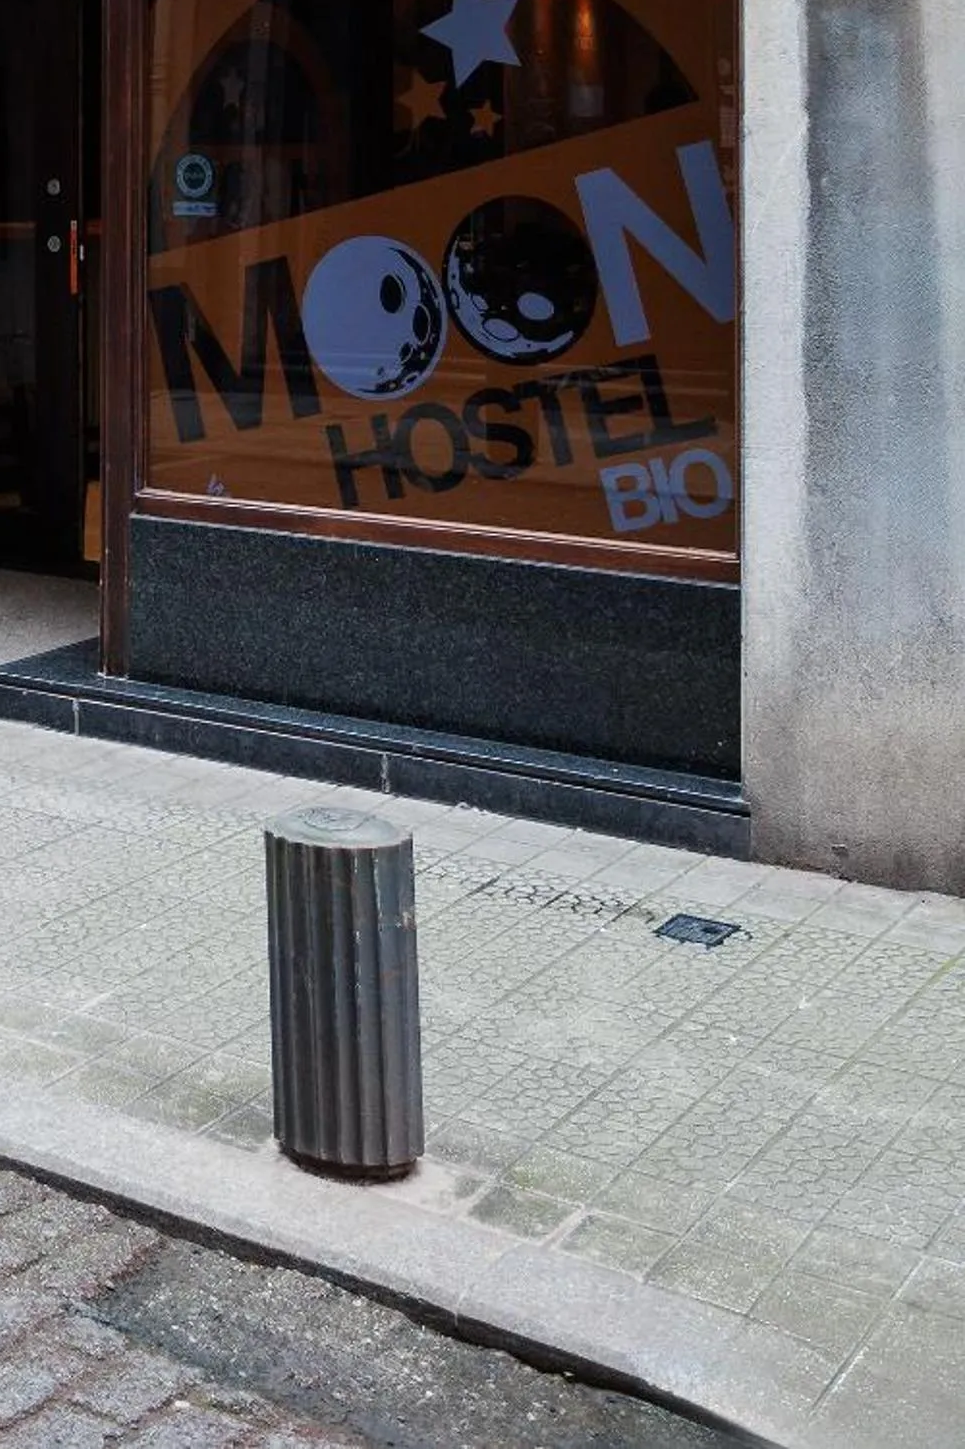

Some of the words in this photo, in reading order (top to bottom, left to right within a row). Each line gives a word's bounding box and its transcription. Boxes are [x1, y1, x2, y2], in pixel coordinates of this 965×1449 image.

[147, 140, 739, 444] MOON
[326, 354, 718, 509] HOSTEL
[599, 448, 733, 533] BIO
